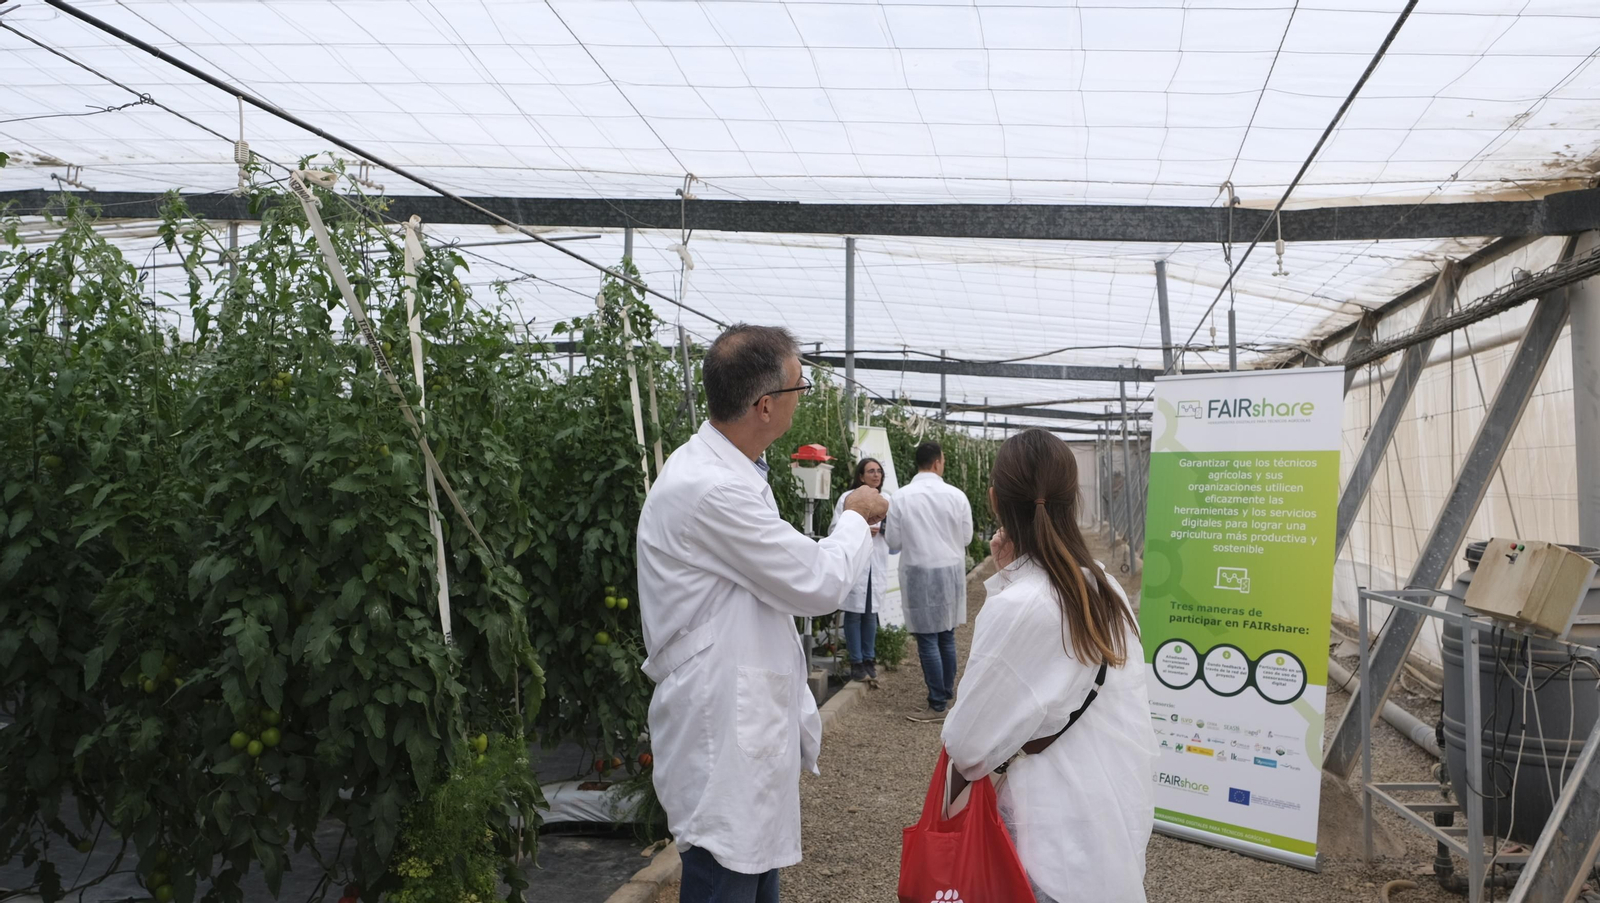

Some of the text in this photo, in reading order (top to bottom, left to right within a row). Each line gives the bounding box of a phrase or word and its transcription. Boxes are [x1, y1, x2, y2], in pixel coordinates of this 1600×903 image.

[1207, 397, 1315, 419] FAIRshare
[1178, 458, 1317, 470] Garantizar que los técnicos
[1208, 470, 1283, 481] agrícolas y sus
[1188, 482, 1304, 493] organizaciones utilicen
[1204, 494, 1284, 505] eficazmente las
[1174, 505, 1317, 518] herramientas y los servicios
[1181, 517, 1307, 532] digitales para lograr una
[1170, 529, 1317, 545] agricultura más productiva y
[1213, 543, 1264, 554] sostenible
[1170, 601, 1263, 618] Tres maneras de
[1169, 614, 1310, 635] participar en FAIRshare:
[1159, 772, 1210, 793] FAIRshare
